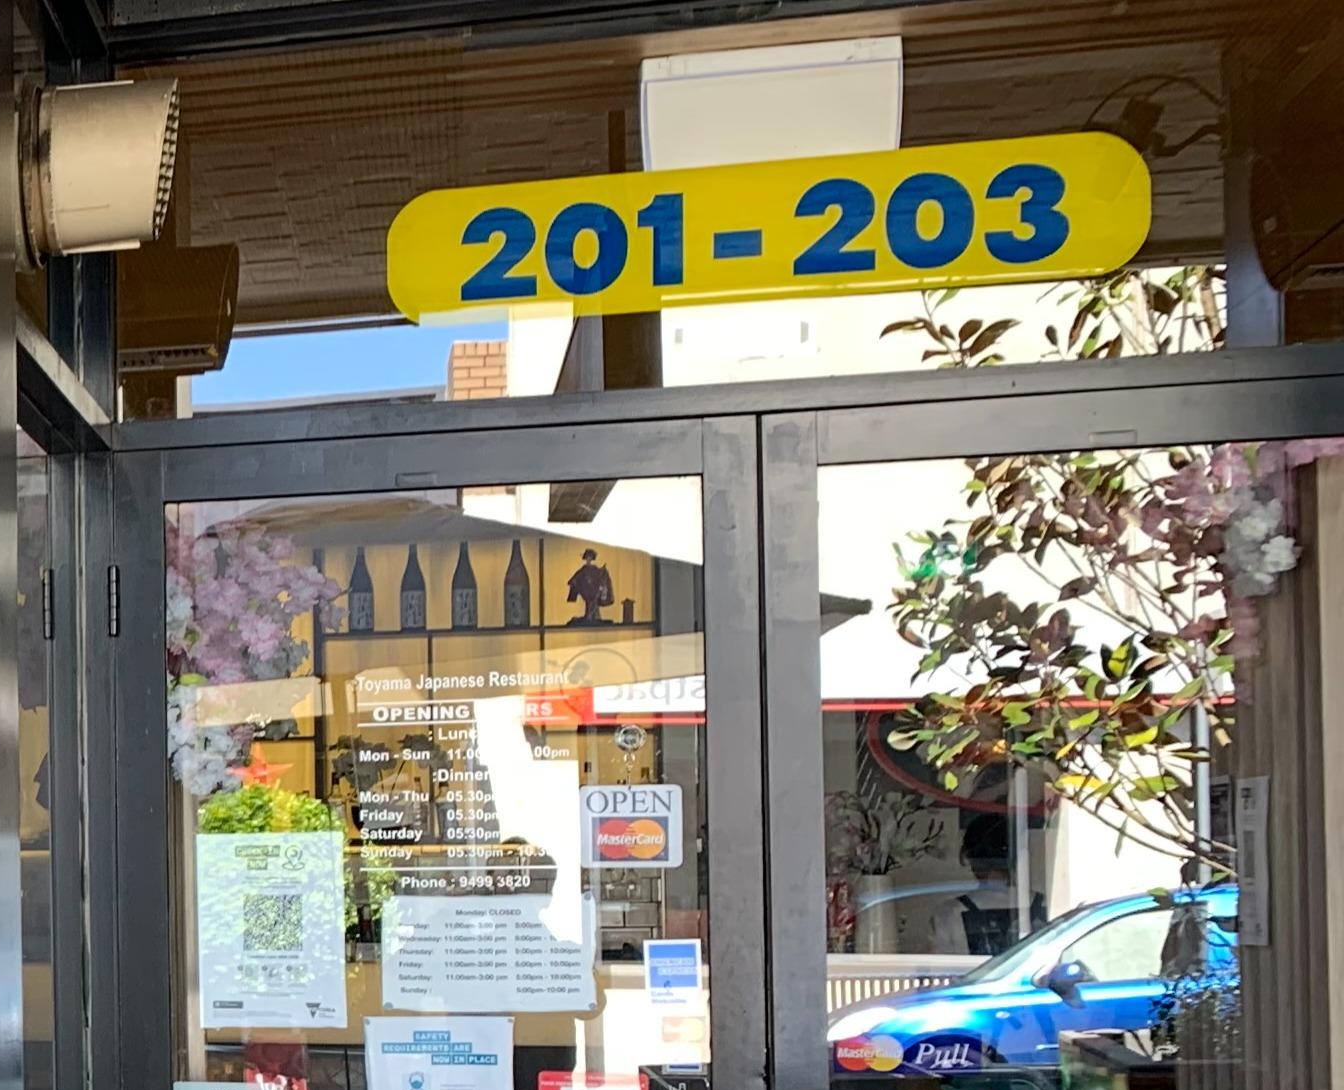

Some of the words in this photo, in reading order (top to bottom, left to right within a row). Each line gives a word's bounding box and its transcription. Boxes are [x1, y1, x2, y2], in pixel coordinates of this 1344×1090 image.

[461, 163, 1071, 303] 201-203
[356, 676, 411, 695] Toyama
[416, 674, 484, 692] Japanese
[489, 671, 569, 686] Restaurant
[373, 705, 470, 721] OPENING
[360, 751, 389, 761] Mon
[403, 749, 430, 760] Sun
[360, 792, 389, 802] Mon
[403, 791, 429, 802] Thu
[586, 790, 675, 814] OPEN
[360, 809, 404, 823] Friday
[360, 828, 423, 842] Saturday
[597, 833, 665, 845] MasterCard
[360, 846, 413, 860] Sunday
[401, 877, 447, 889] Phone
[460, 876, 493, 888] 9499
[414, 1031, 449, 1041] SAFETY
[383, 1043, 450, 1052] REQUIREMENTS
[915, 1043, 970, 1066] Pull
[433, 1056, 450, 1064] NOW
[454, 1056, 464, 1064] IN
[468, 1055, 496, 1064] PLACE
